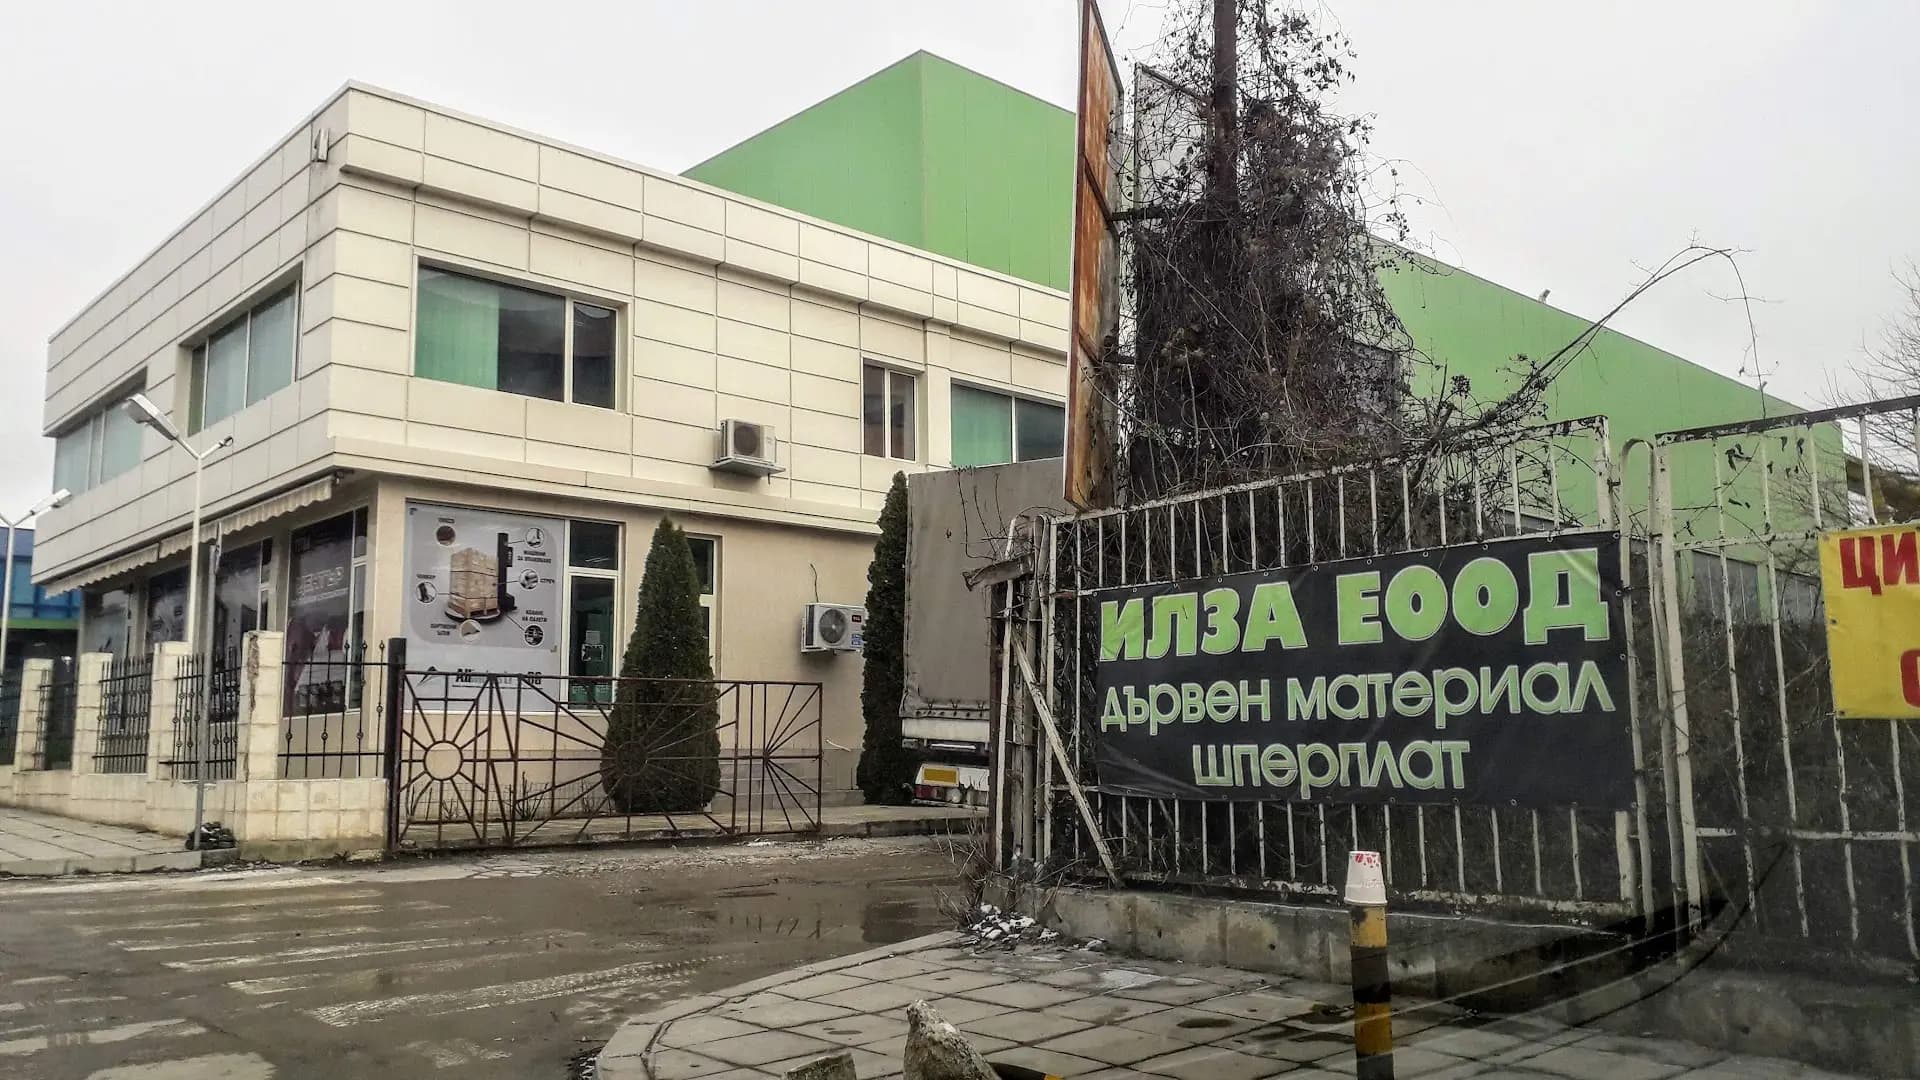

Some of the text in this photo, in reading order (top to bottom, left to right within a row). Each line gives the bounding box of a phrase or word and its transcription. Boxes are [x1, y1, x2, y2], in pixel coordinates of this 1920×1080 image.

[1839, 531, 1920, 595] ЦИ
[1099, 547, 1610, 662] ИЛЗА ЕООД
[1101, 660, 1616, 736] дървен материал
[1192, 739, 1470, 800] шперплат
